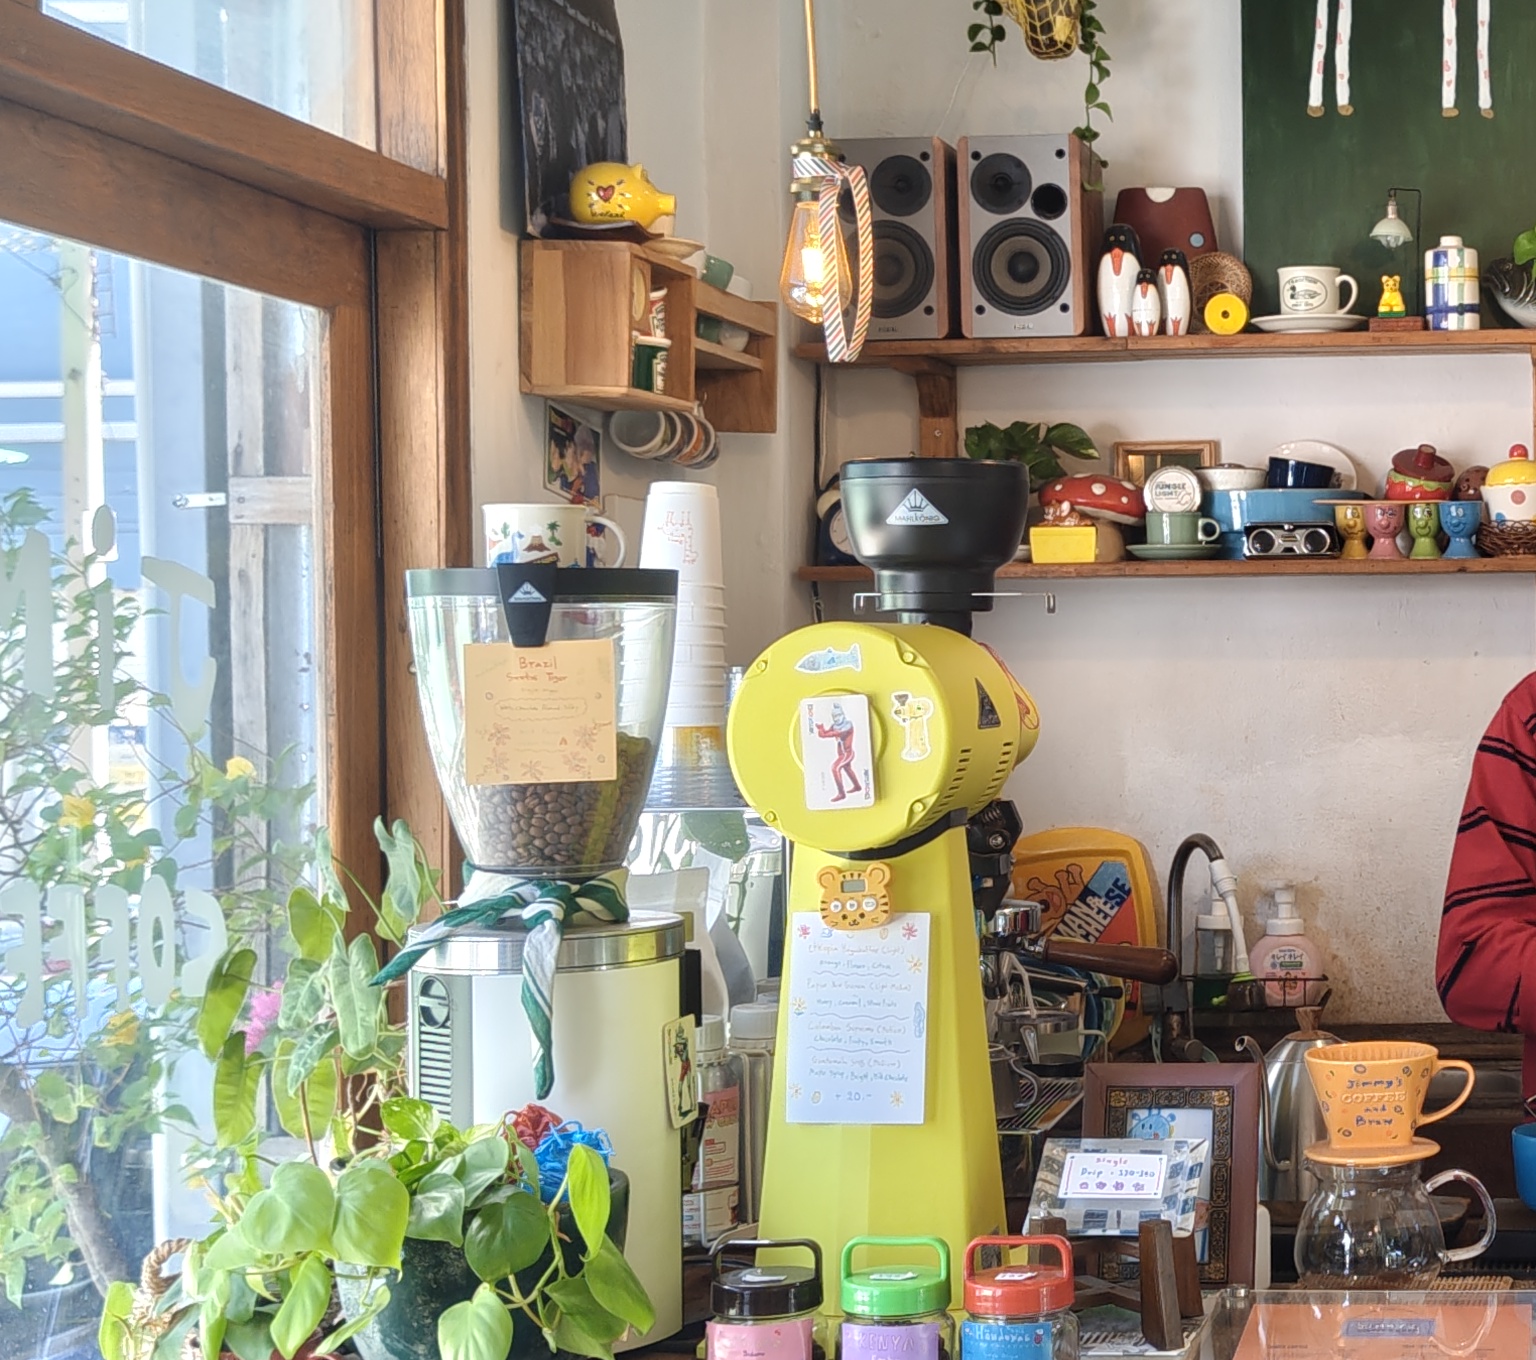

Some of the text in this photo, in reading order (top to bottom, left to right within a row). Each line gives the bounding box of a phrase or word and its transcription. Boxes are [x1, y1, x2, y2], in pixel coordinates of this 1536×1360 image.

[518, 656, 557, 669] Brazil
[1341, 1091, 1407, 1104] COFFEE
[858, 1332, 915, 1352] KENYA
